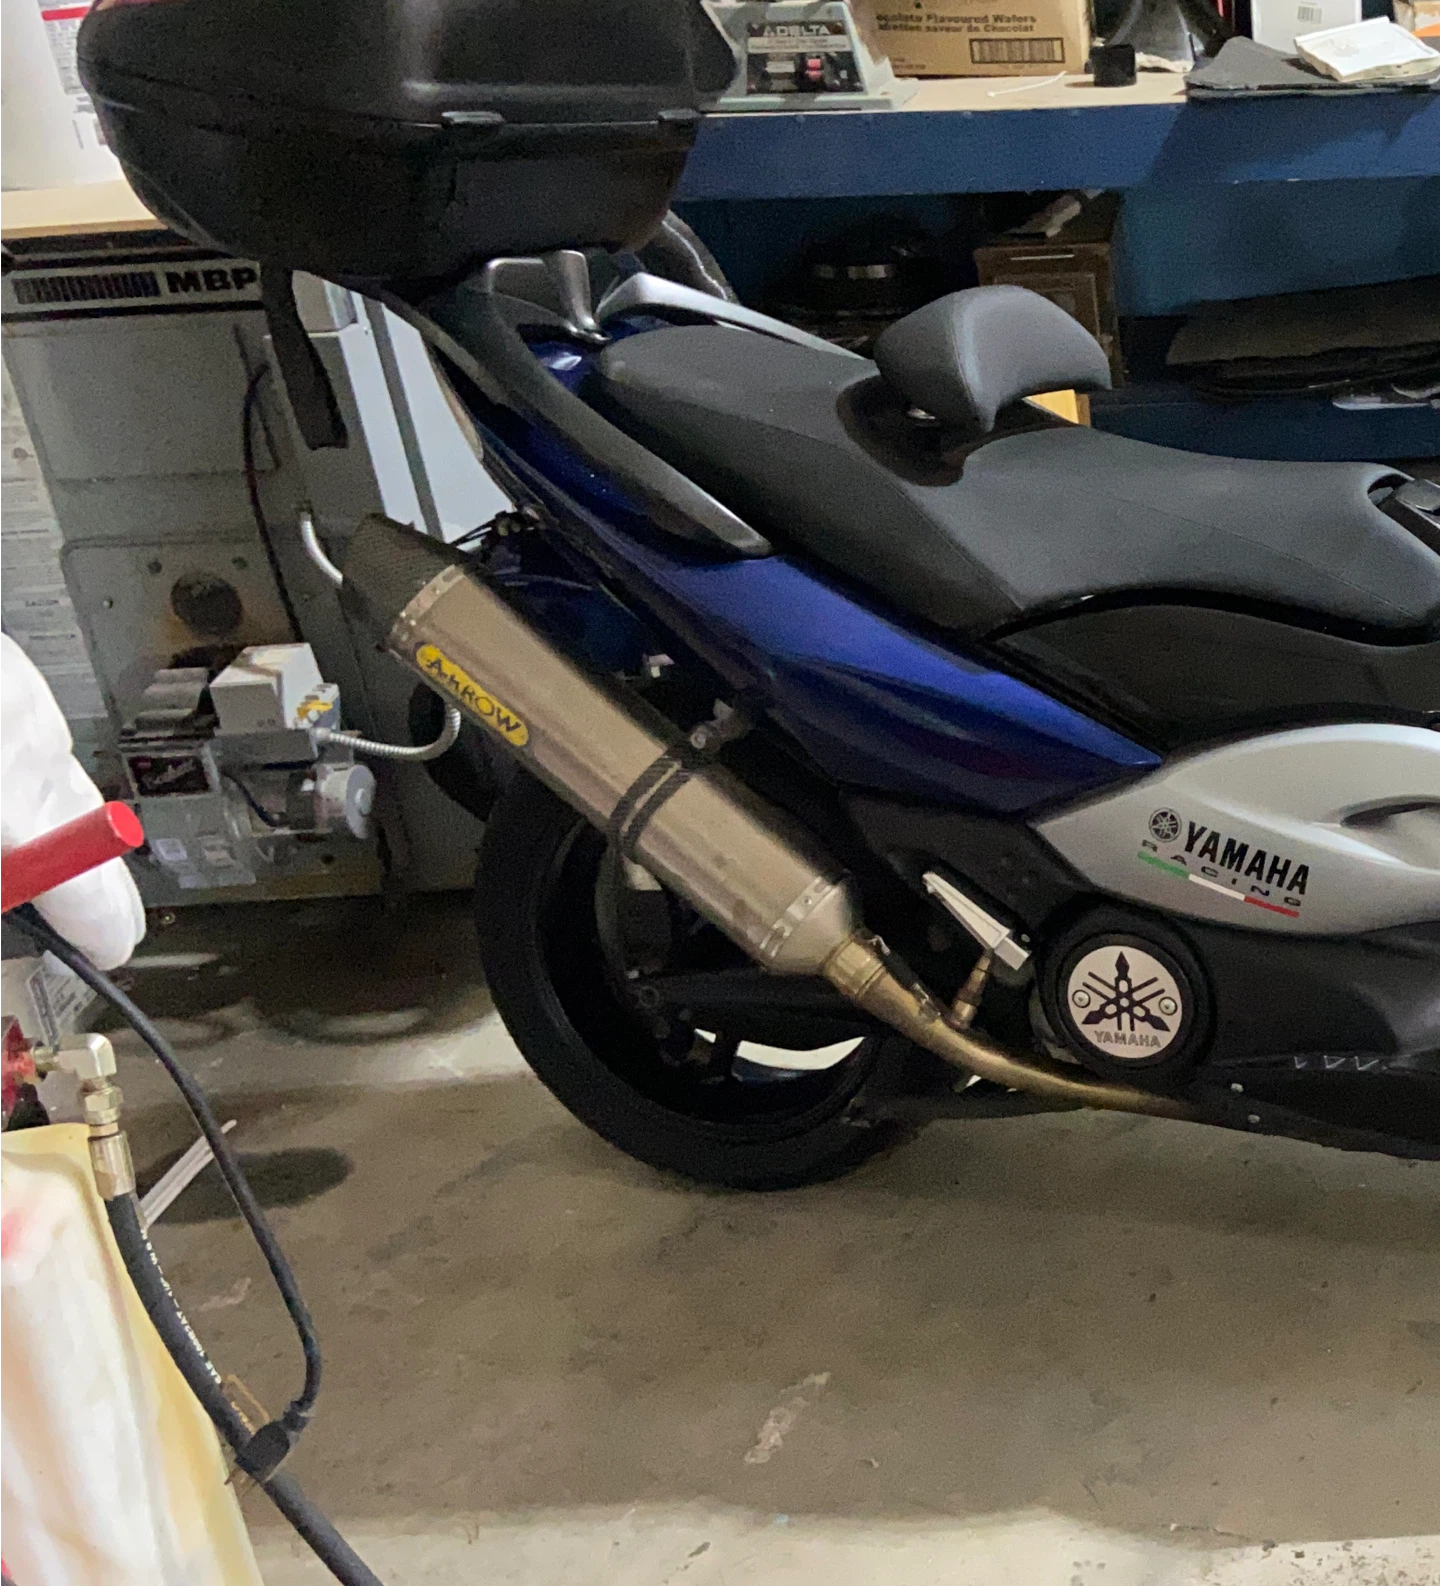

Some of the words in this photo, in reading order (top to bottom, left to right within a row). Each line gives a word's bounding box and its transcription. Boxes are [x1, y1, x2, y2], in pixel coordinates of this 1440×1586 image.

[926, 13, 989, 23] Flavoured
[992, 14, 1036, 23] Wafers
[776, 24, 831, 36] DELTA
[984, 23, 1034, 33] Chocolat
[165, 266, 257, 295] MBP
[1184, 821, 1310, 895] YAMAHA
[1094, 1030, 1161, 1048] YAMAHA
